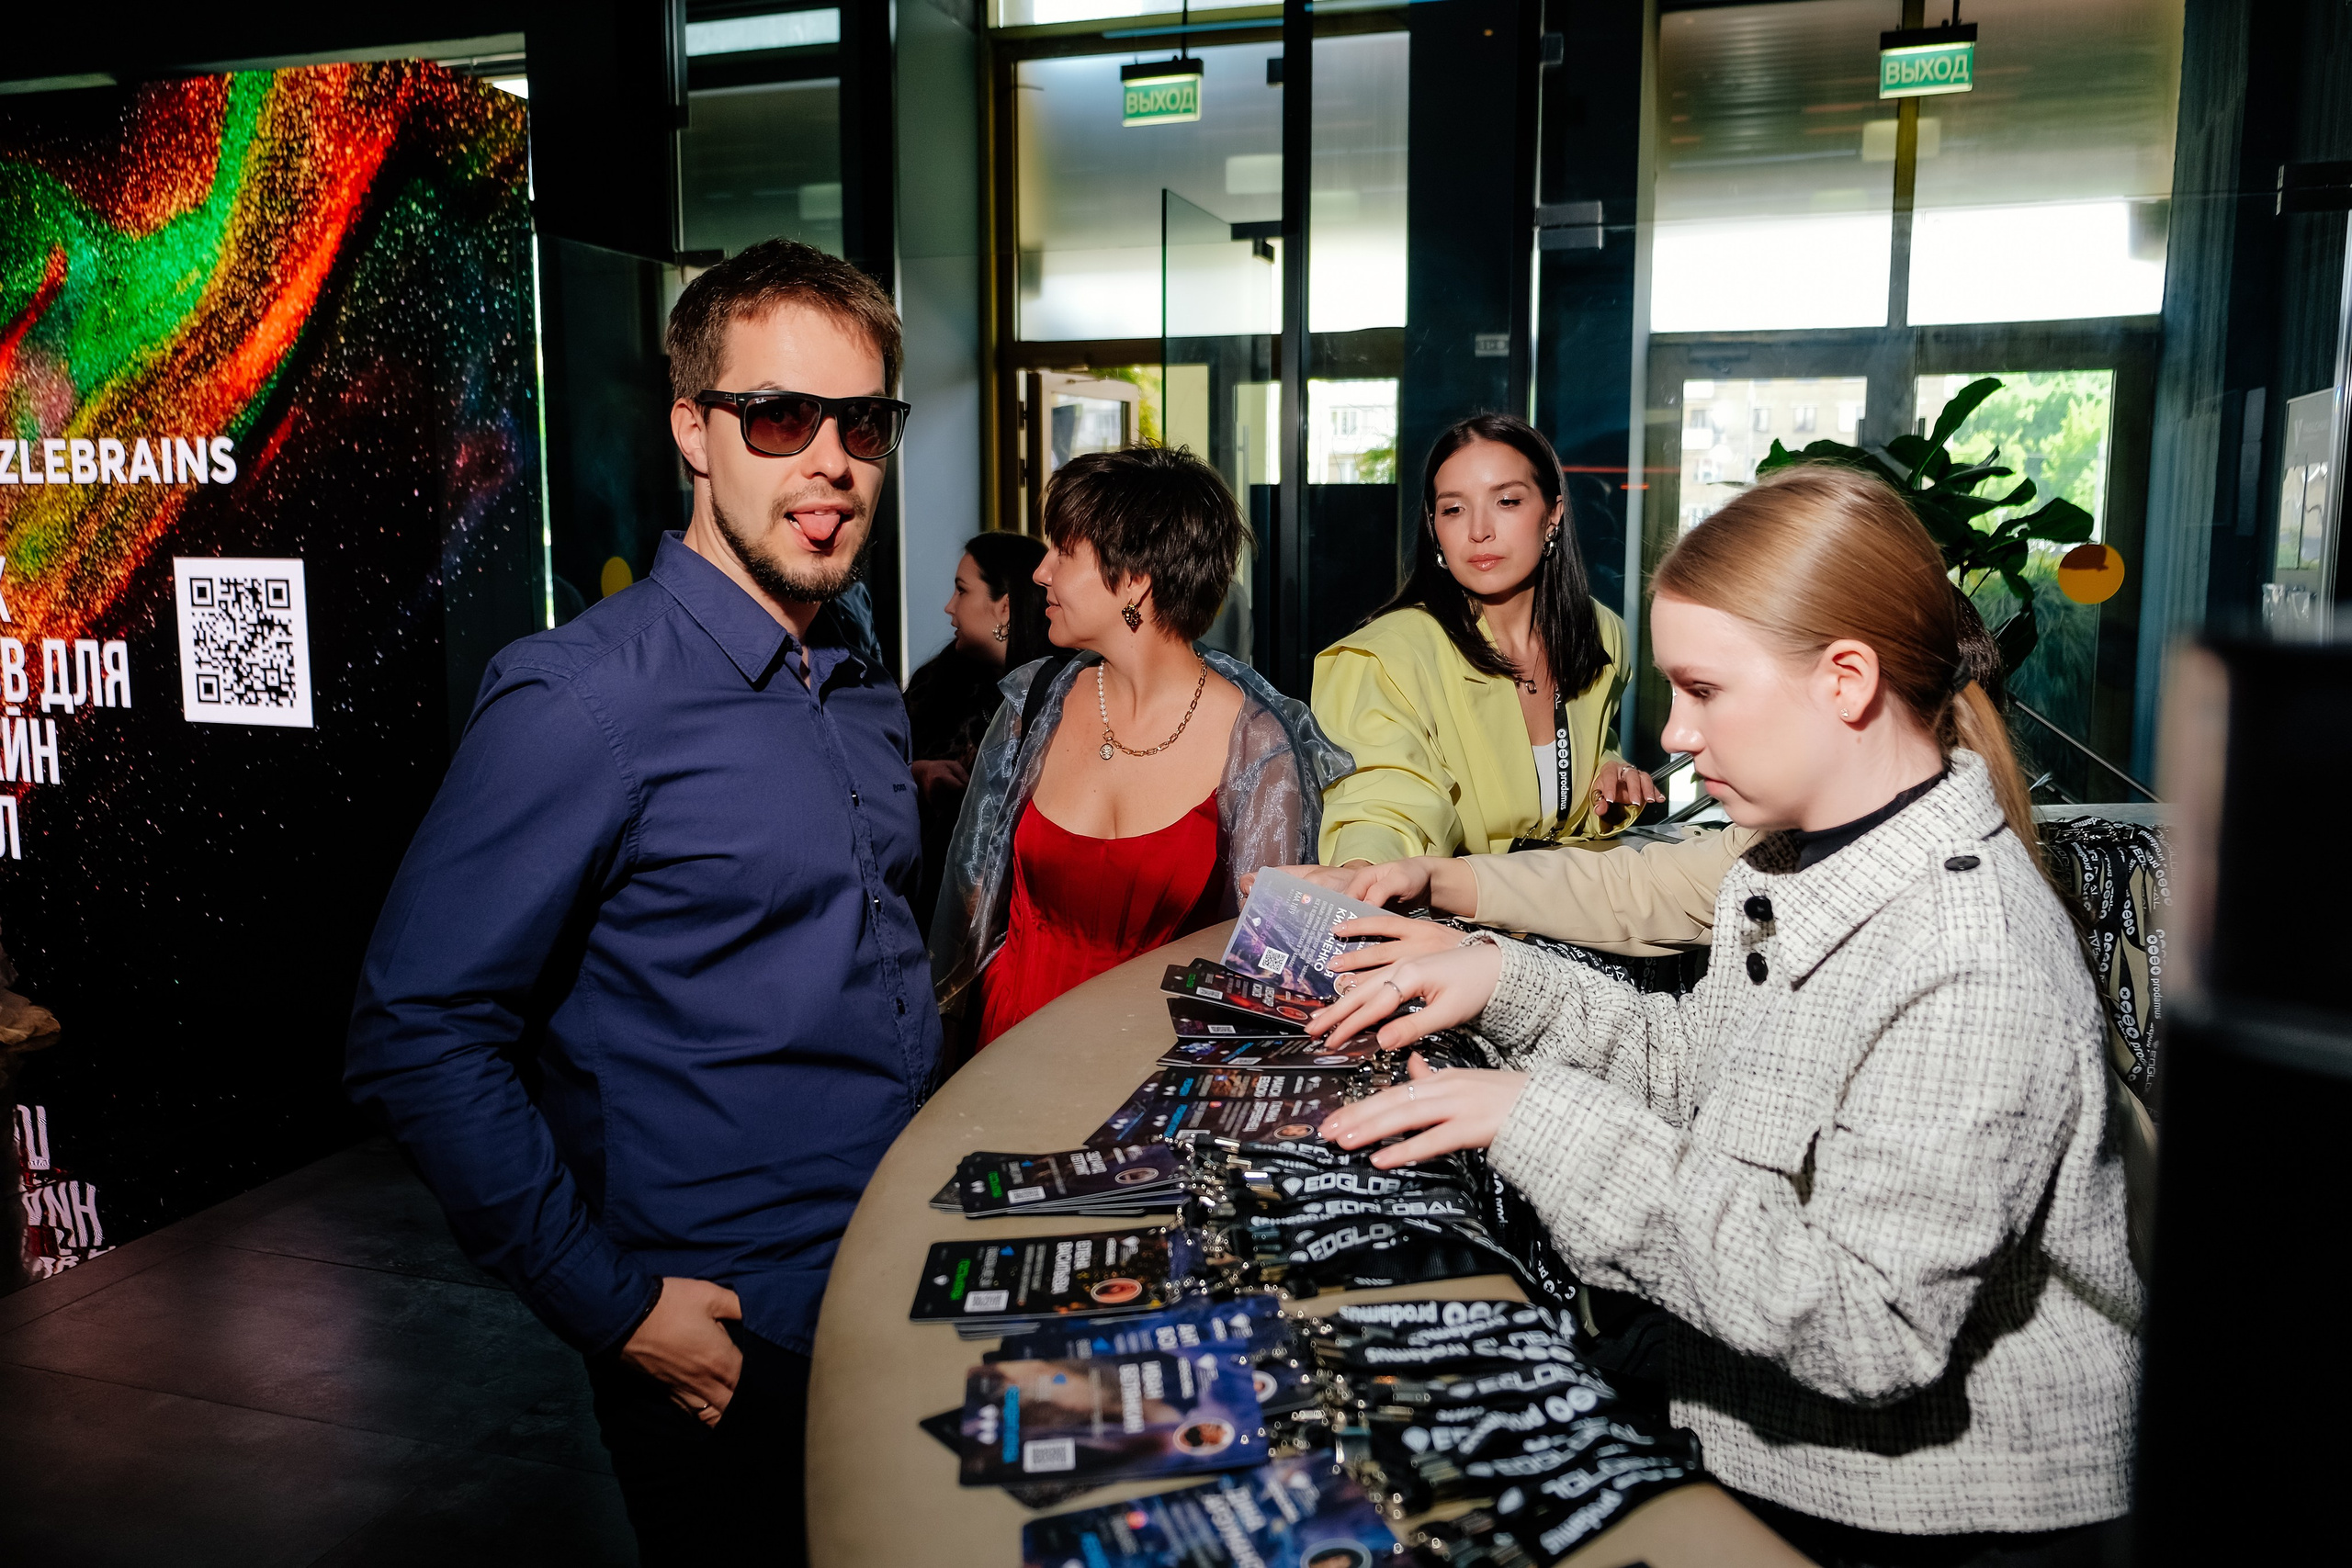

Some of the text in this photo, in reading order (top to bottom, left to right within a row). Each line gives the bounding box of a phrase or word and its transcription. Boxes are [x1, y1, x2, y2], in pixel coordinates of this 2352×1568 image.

[1885, 54, 1969, 85] ВЫХОД
[1125, 86, 1195, 115] ВЫХОД
[40, 638, 132, 714] ДЛЯ
[0, 705, 61, 785] ЙН
[1558, 771, 1567, 811] prodamus
[2071, 817, 2101, 829] damus
[1324, 910, 1359, 978] АСТАЯ
[2151, 978, 2163, 1020] prodamus
[1305, 1172, 1410, 1195] EDGLOB
[1306, 1223, 1396, 1261] EDGLO
[1339, 1302, 1437, 1328] prodamus
